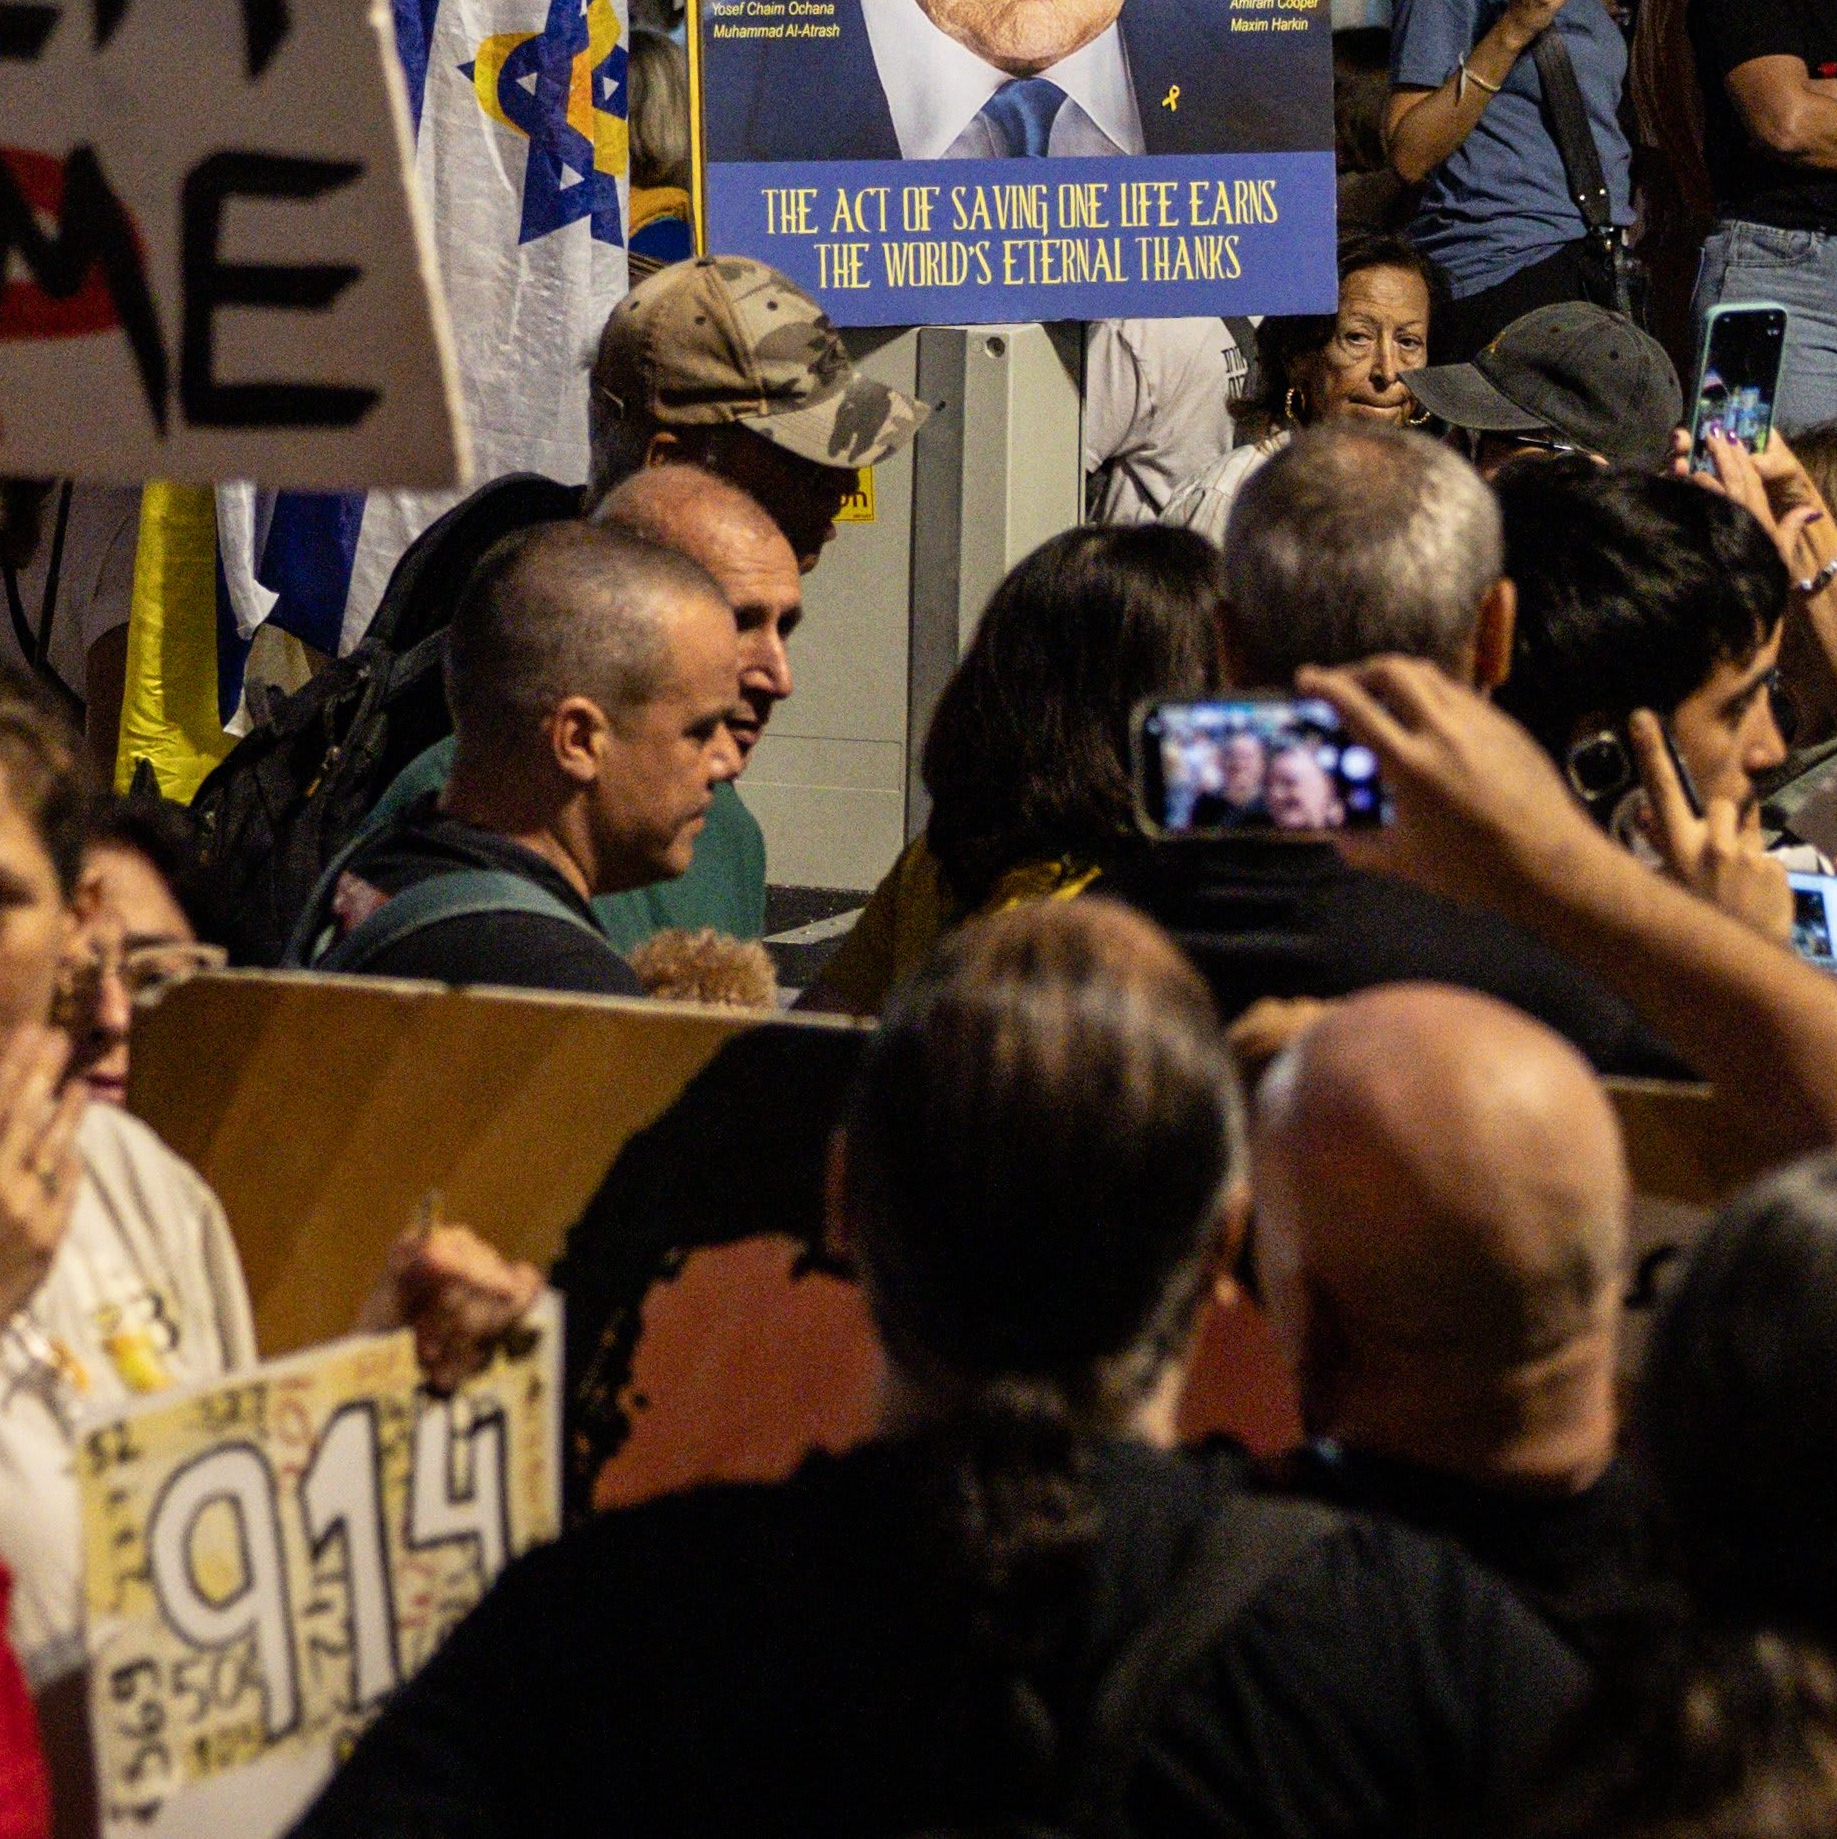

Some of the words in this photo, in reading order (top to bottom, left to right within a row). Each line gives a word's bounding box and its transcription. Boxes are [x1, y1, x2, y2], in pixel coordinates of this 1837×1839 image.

[712, 3, 743, 15] Yosef
[747, 3, 784, 15] Chaim
[789, 3, 834, 15] Ochana
[714, 25, 783, 37] Muhammad
[785, 25, 840, 37] Al-Atrash
[1231, 19, 1267, 31] Maxim
[1271, 19, 1308, 30] Harkin
[762, 188, 818, 234] THE
[831, 187, 890, 232] ACT
[902, 186, 940, 232] OF
[952, 184, 1047, 235] SAVING
[1058, 184, 1108, 228] ONE
[1120, 182, 1179, 228] LIFE
[1189, 179, 1278, 226] EARNS
[814, 243, 870, 289] THE
[883, 241, 993, 287] WORLD'S
[1003, 237, 1128, 284] ETERNAL
[1135, 235, 1242, 281] THANKS
